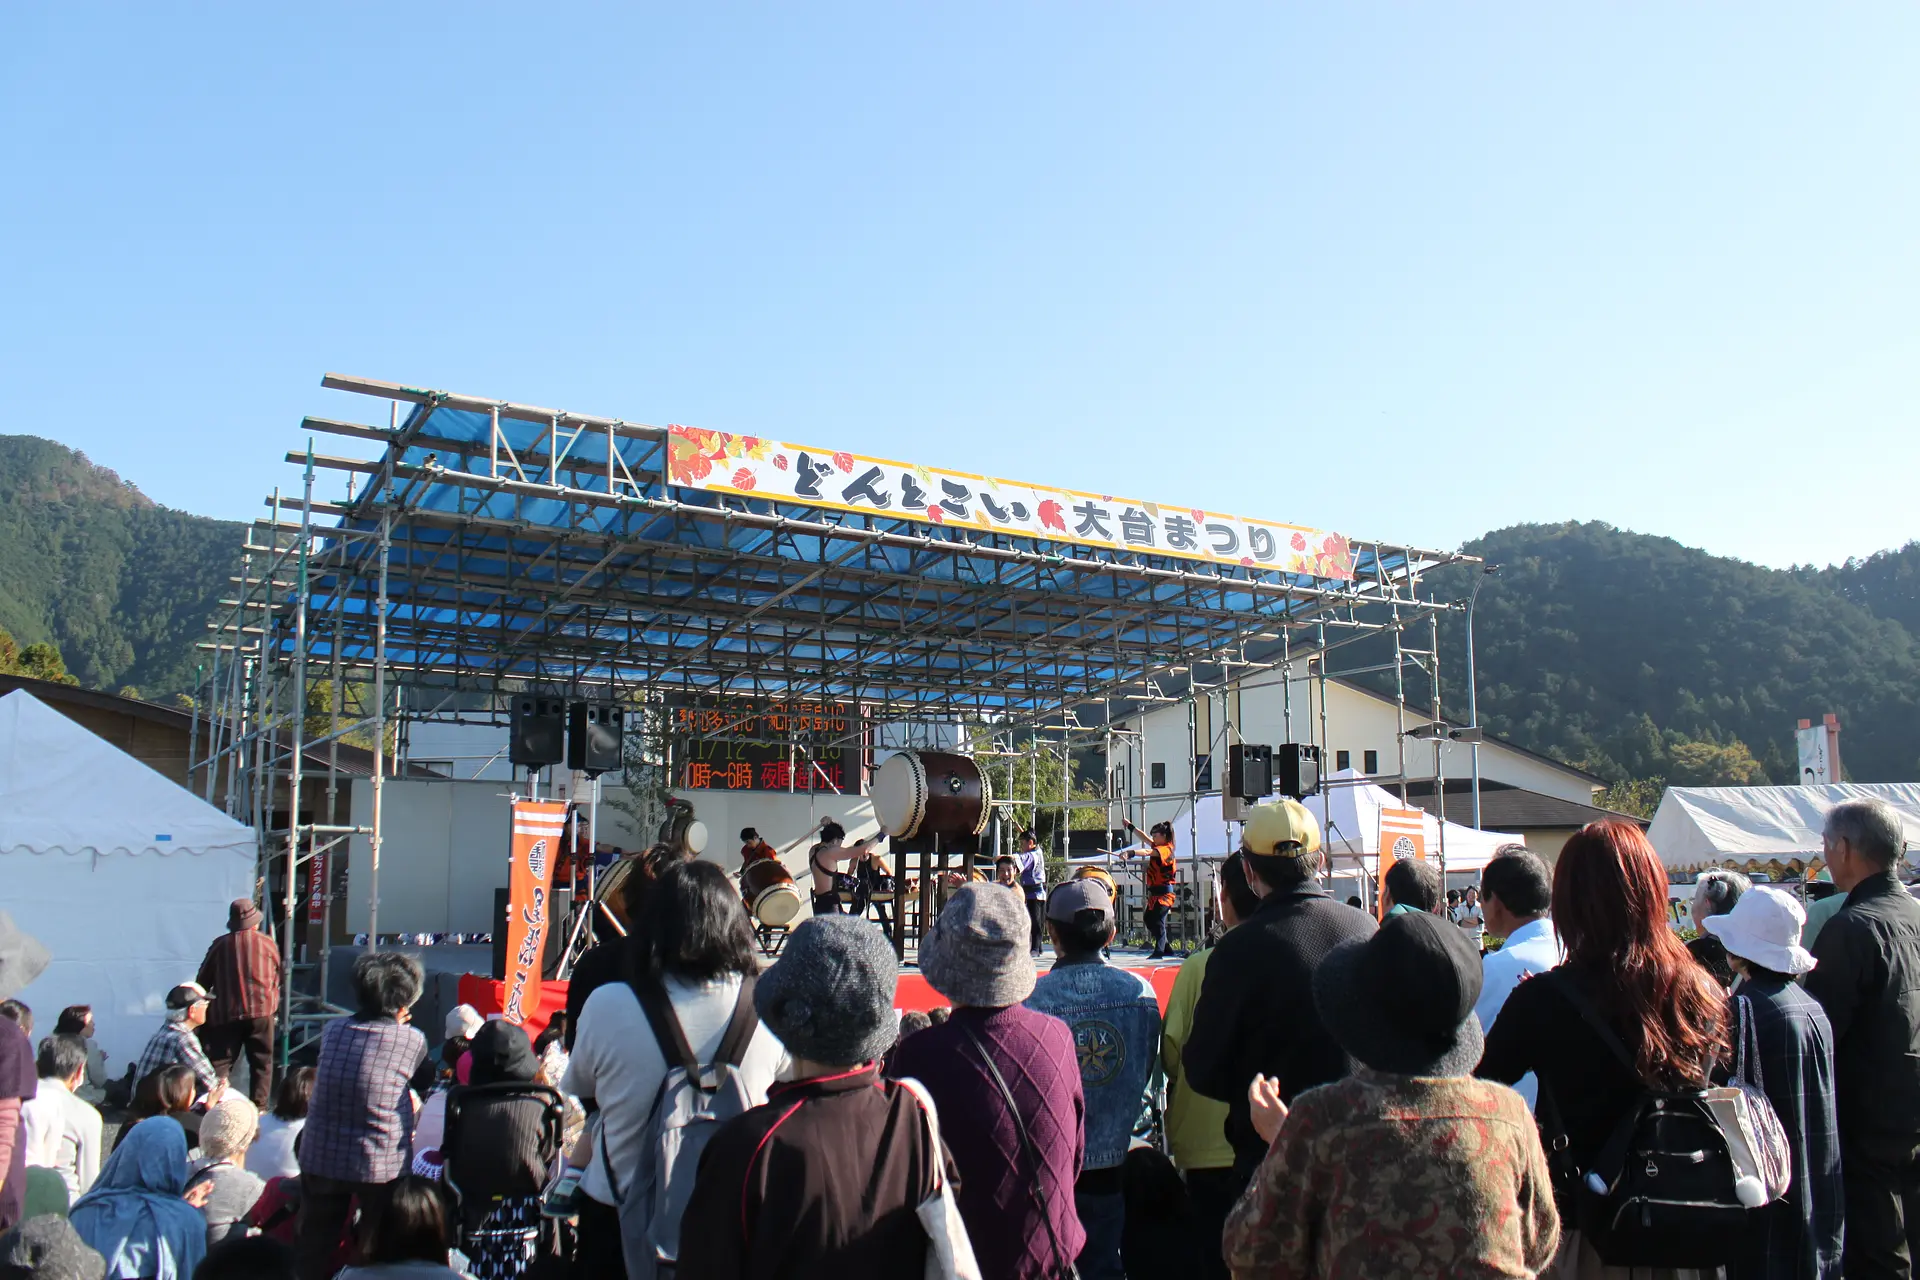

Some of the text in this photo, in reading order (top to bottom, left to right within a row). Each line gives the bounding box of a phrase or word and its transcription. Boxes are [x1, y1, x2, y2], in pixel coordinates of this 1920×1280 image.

[794, 451, 1277, 562] どんとこい 大台まつり
[760, 762, 845, 789] 夜間通行止
